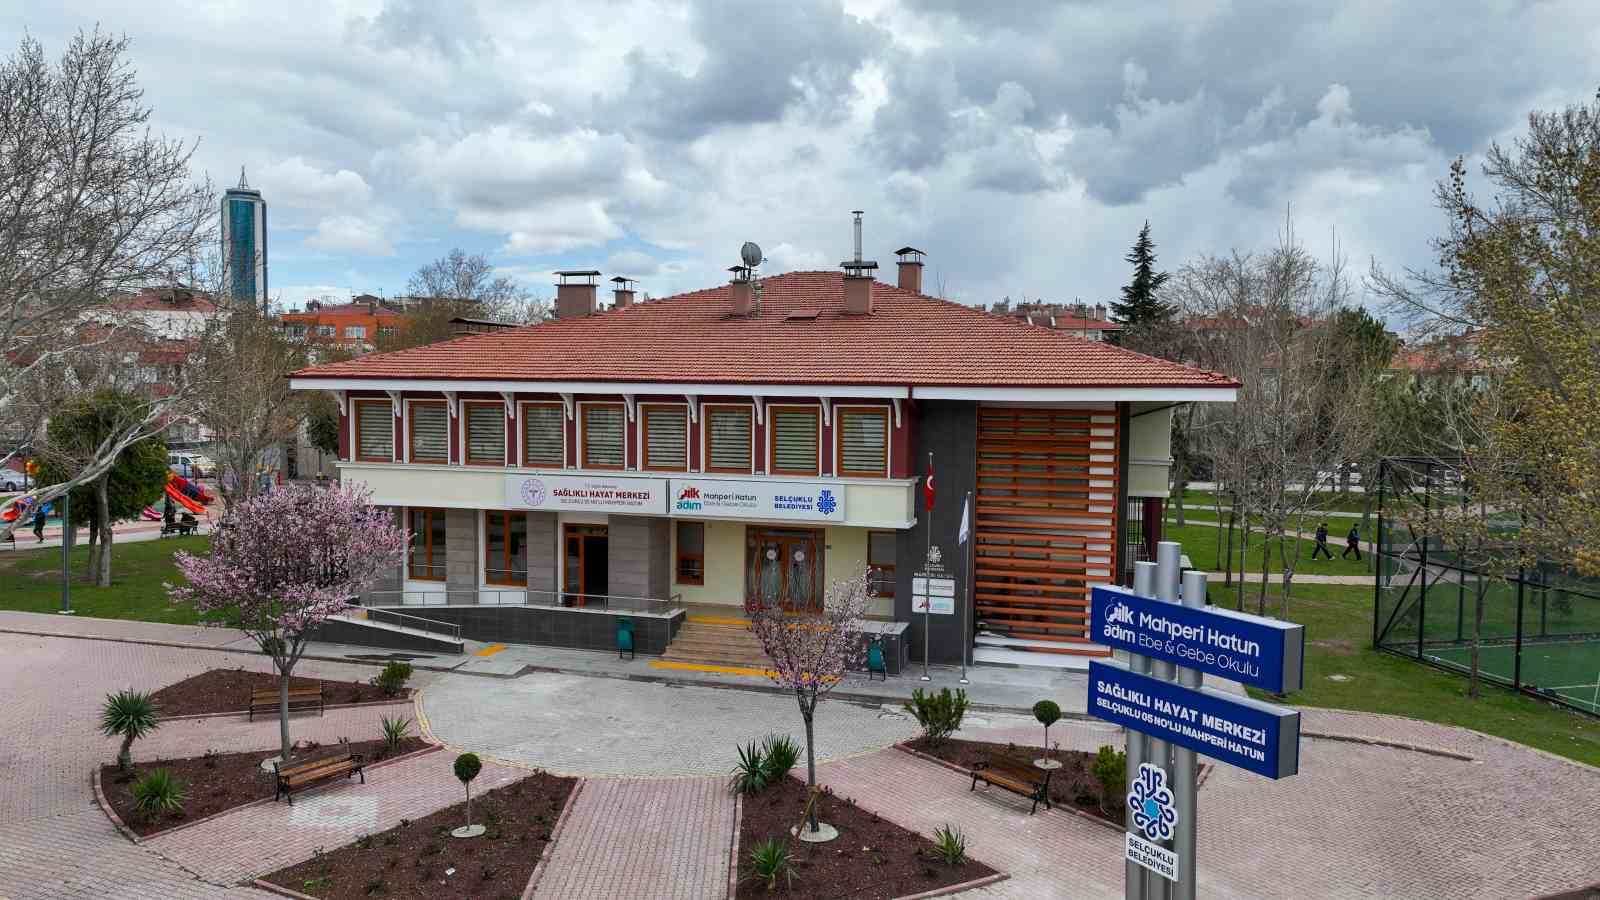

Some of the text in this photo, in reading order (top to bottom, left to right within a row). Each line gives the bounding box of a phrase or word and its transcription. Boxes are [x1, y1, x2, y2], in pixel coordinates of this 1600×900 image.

[553, 487, 650, 500] SAĞLIKLI HAYAT MERKEZİ
[1138, 634, 1260, 678] Ebe & Gebe Okulu
[1139, 612, 1260, 657] Mahperi Hatun
[1096, 697, 1265, 762] SELÇUKLU 05 NO'LU MAHPERİ HATUN
[1097, 680, 1266, 746] SAĞLIKLI HAYAT MERKEZİ
[1128, 837, 1174, 865] SELÇUKLU
[1128, 849, 1174, 878] BELEDİYESİ
